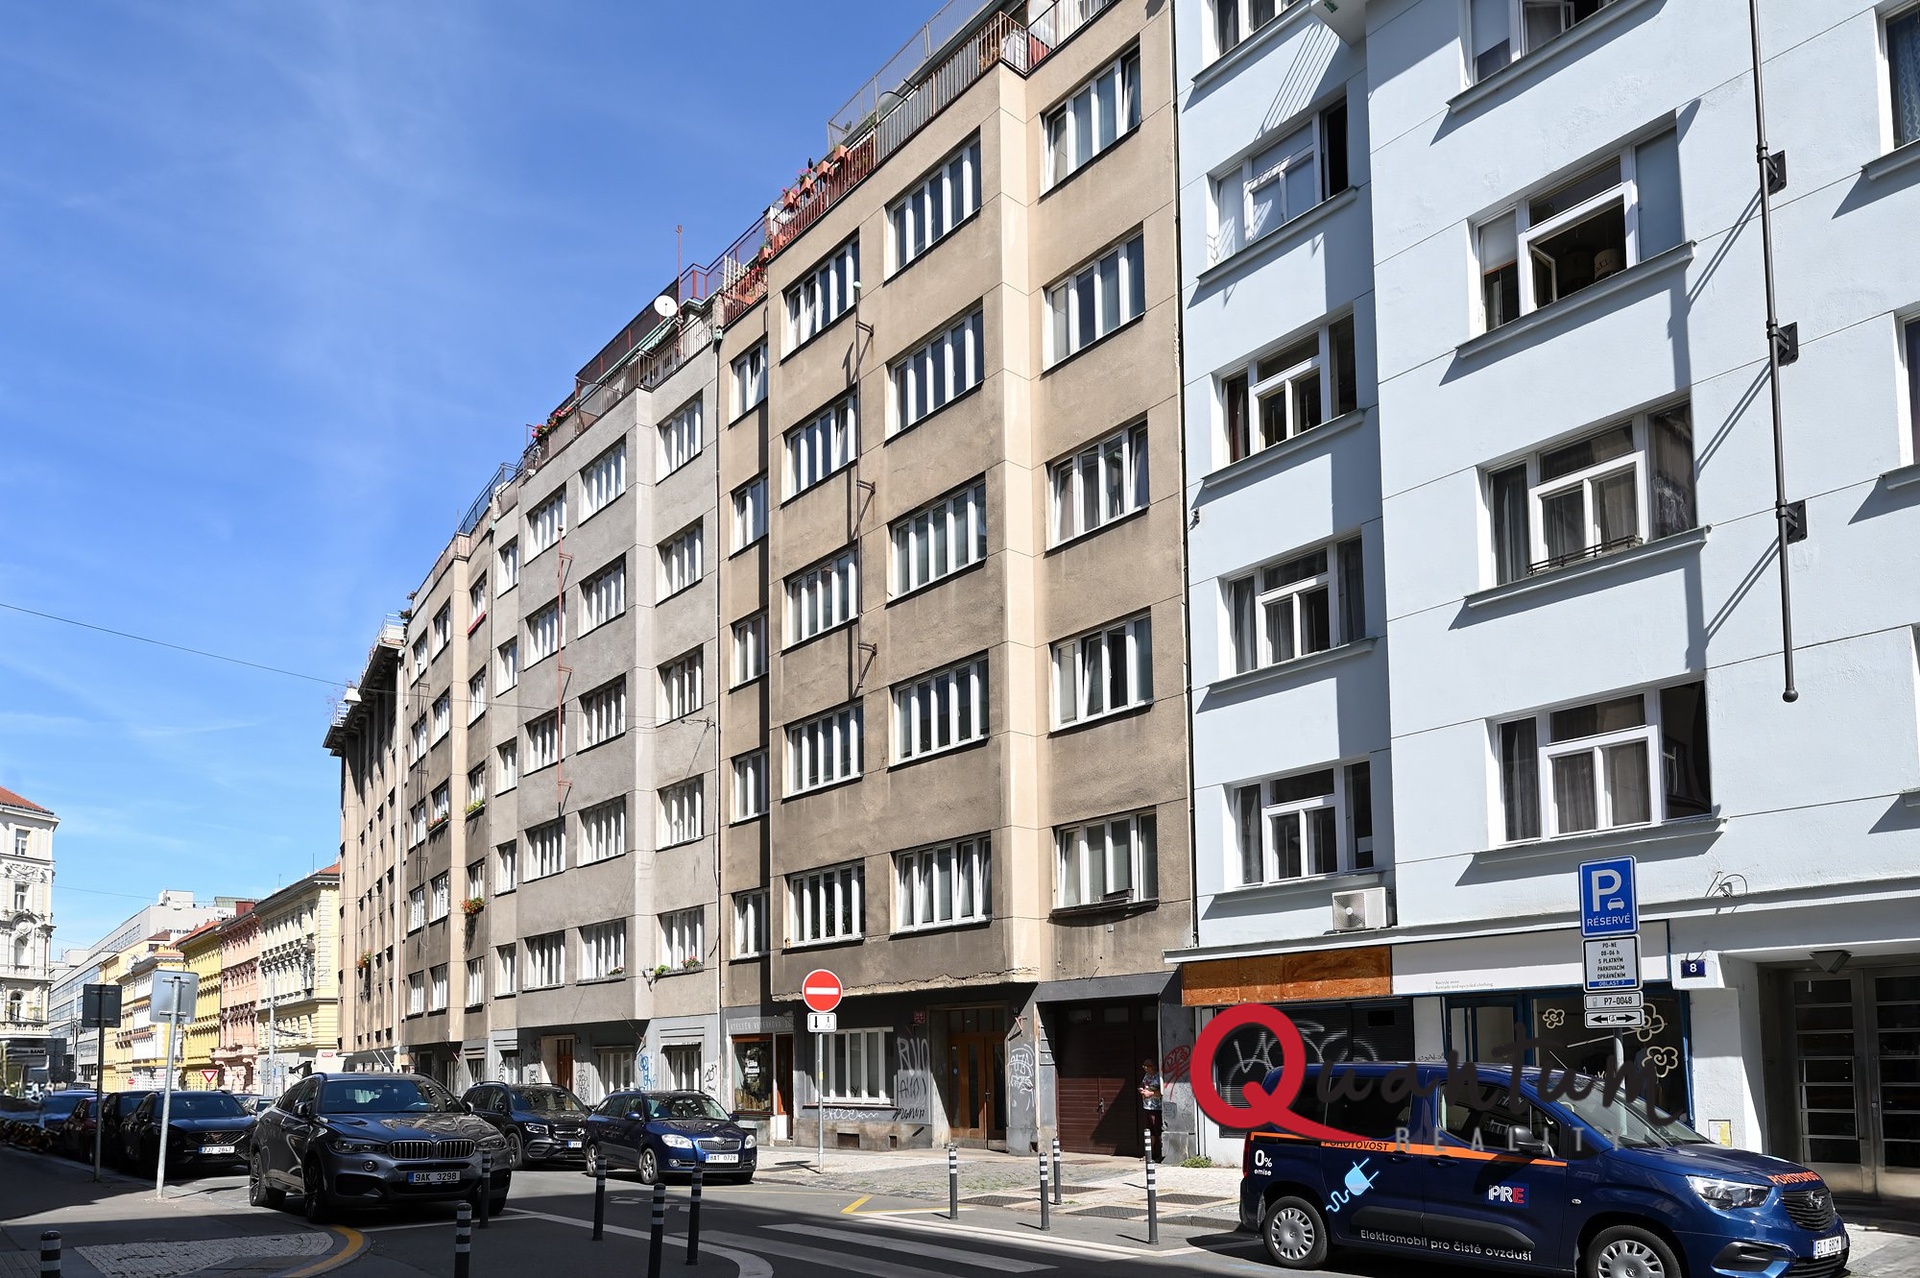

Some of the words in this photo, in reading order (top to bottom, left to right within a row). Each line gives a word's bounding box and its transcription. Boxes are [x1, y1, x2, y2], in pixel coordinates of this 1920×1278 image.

[1591, 869, 1622, 912] P
[1587, 913, 1631, 927] RÉSERVÉ
[1689, 963, 1698, 973] 8
[1254, 1149, 1273, 1168] 0%
[415, 1173, 430, 1182] 9AK
[437, 1172, 457, 1181] 3298
[1254, 1168, 1272, 1176] emise
[1488, 1185, 1525, 1204] PRE
[1360, 1229, 1428, 1247] Elektromobil
[1430, 1240, 1450, 1250] pro
[1453, 1241, 1482, 1255] čisté
[1485, 1247, 1532, 1262] ovzduší
